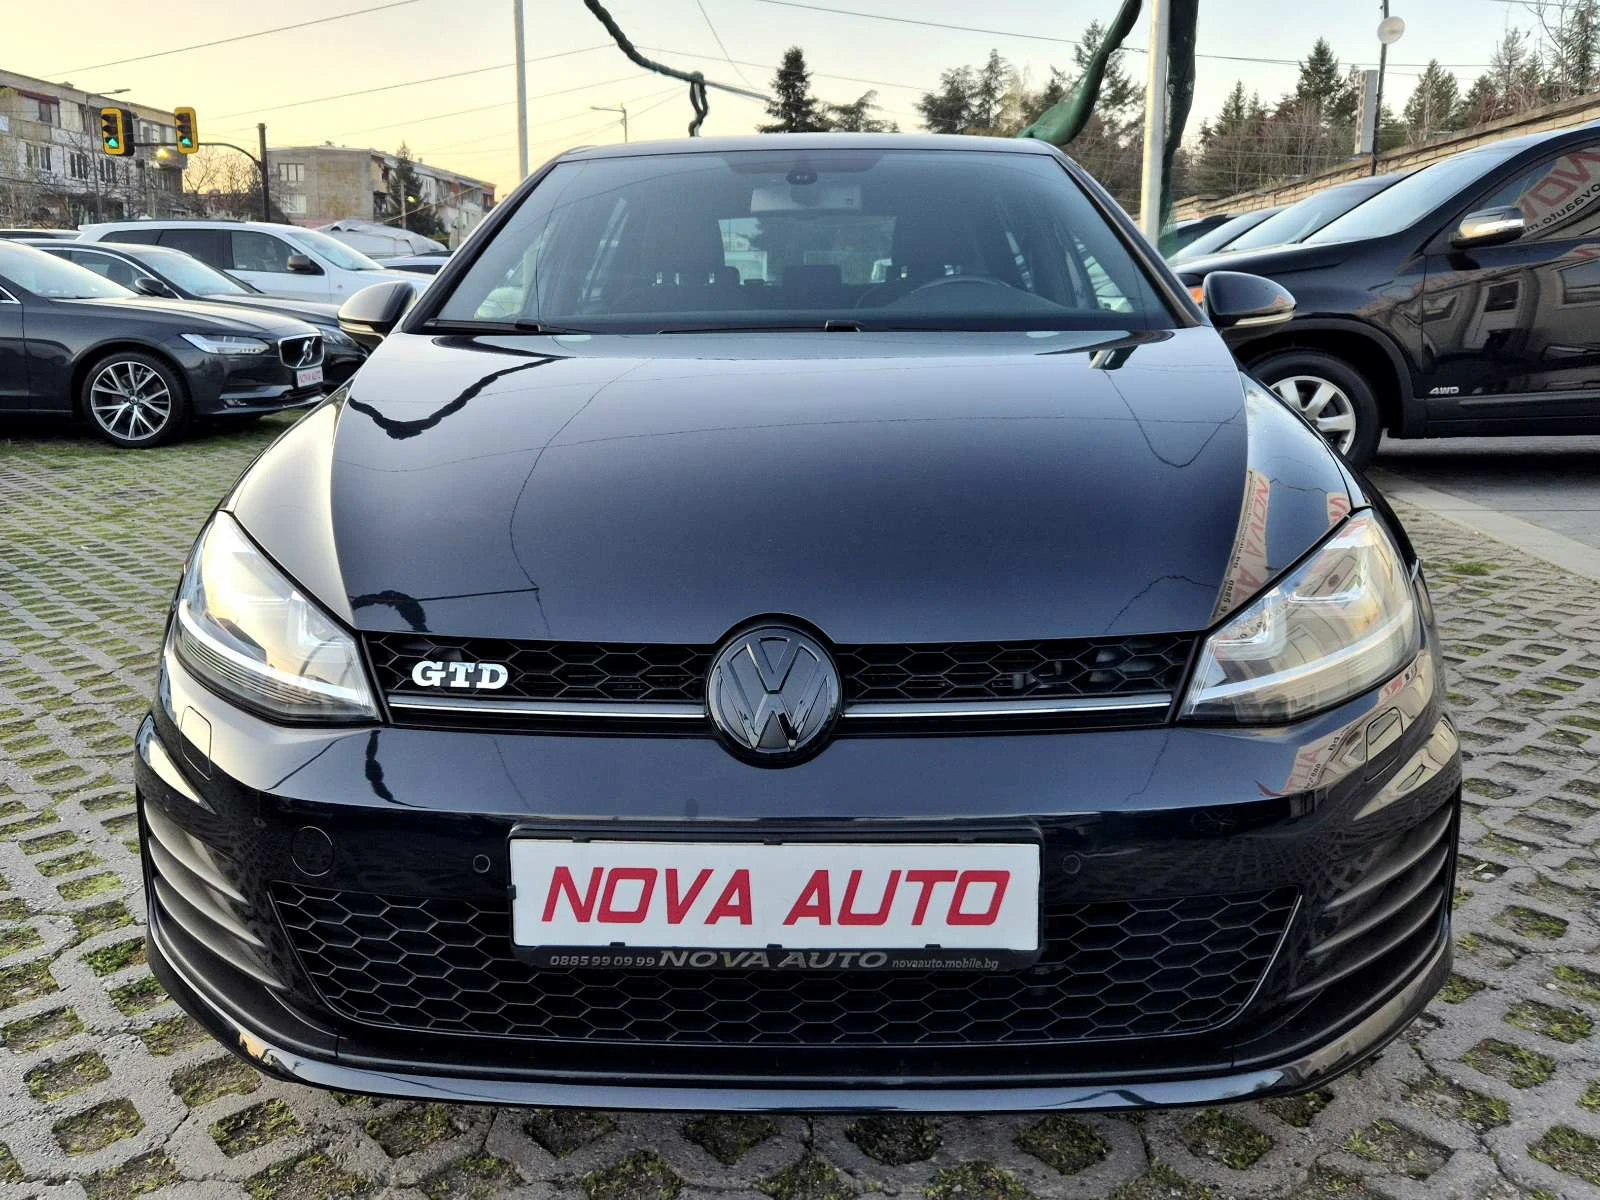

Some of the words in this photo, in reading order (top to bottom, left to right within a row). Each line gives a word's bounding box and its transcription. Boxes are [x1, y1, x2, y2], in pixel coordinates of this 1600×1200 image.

[1429, 386, 1459, 394] 4WD
[411, 660, 508, 689] GTD
[541, 866, 753, 925] NOVA
[782, 869, 1010, 926] AUTO
[550, 955, 589, 966] 0885
[591, 956, 610, 966] 99
[613, 956, 632, 967] 09
[635, 956, 655, 967] 99
[659, 950, 770, 968] NOVA
[777, 951, 888, 969] AUTO
[891, 957, 999, 971] novaauto.mobile.bg
